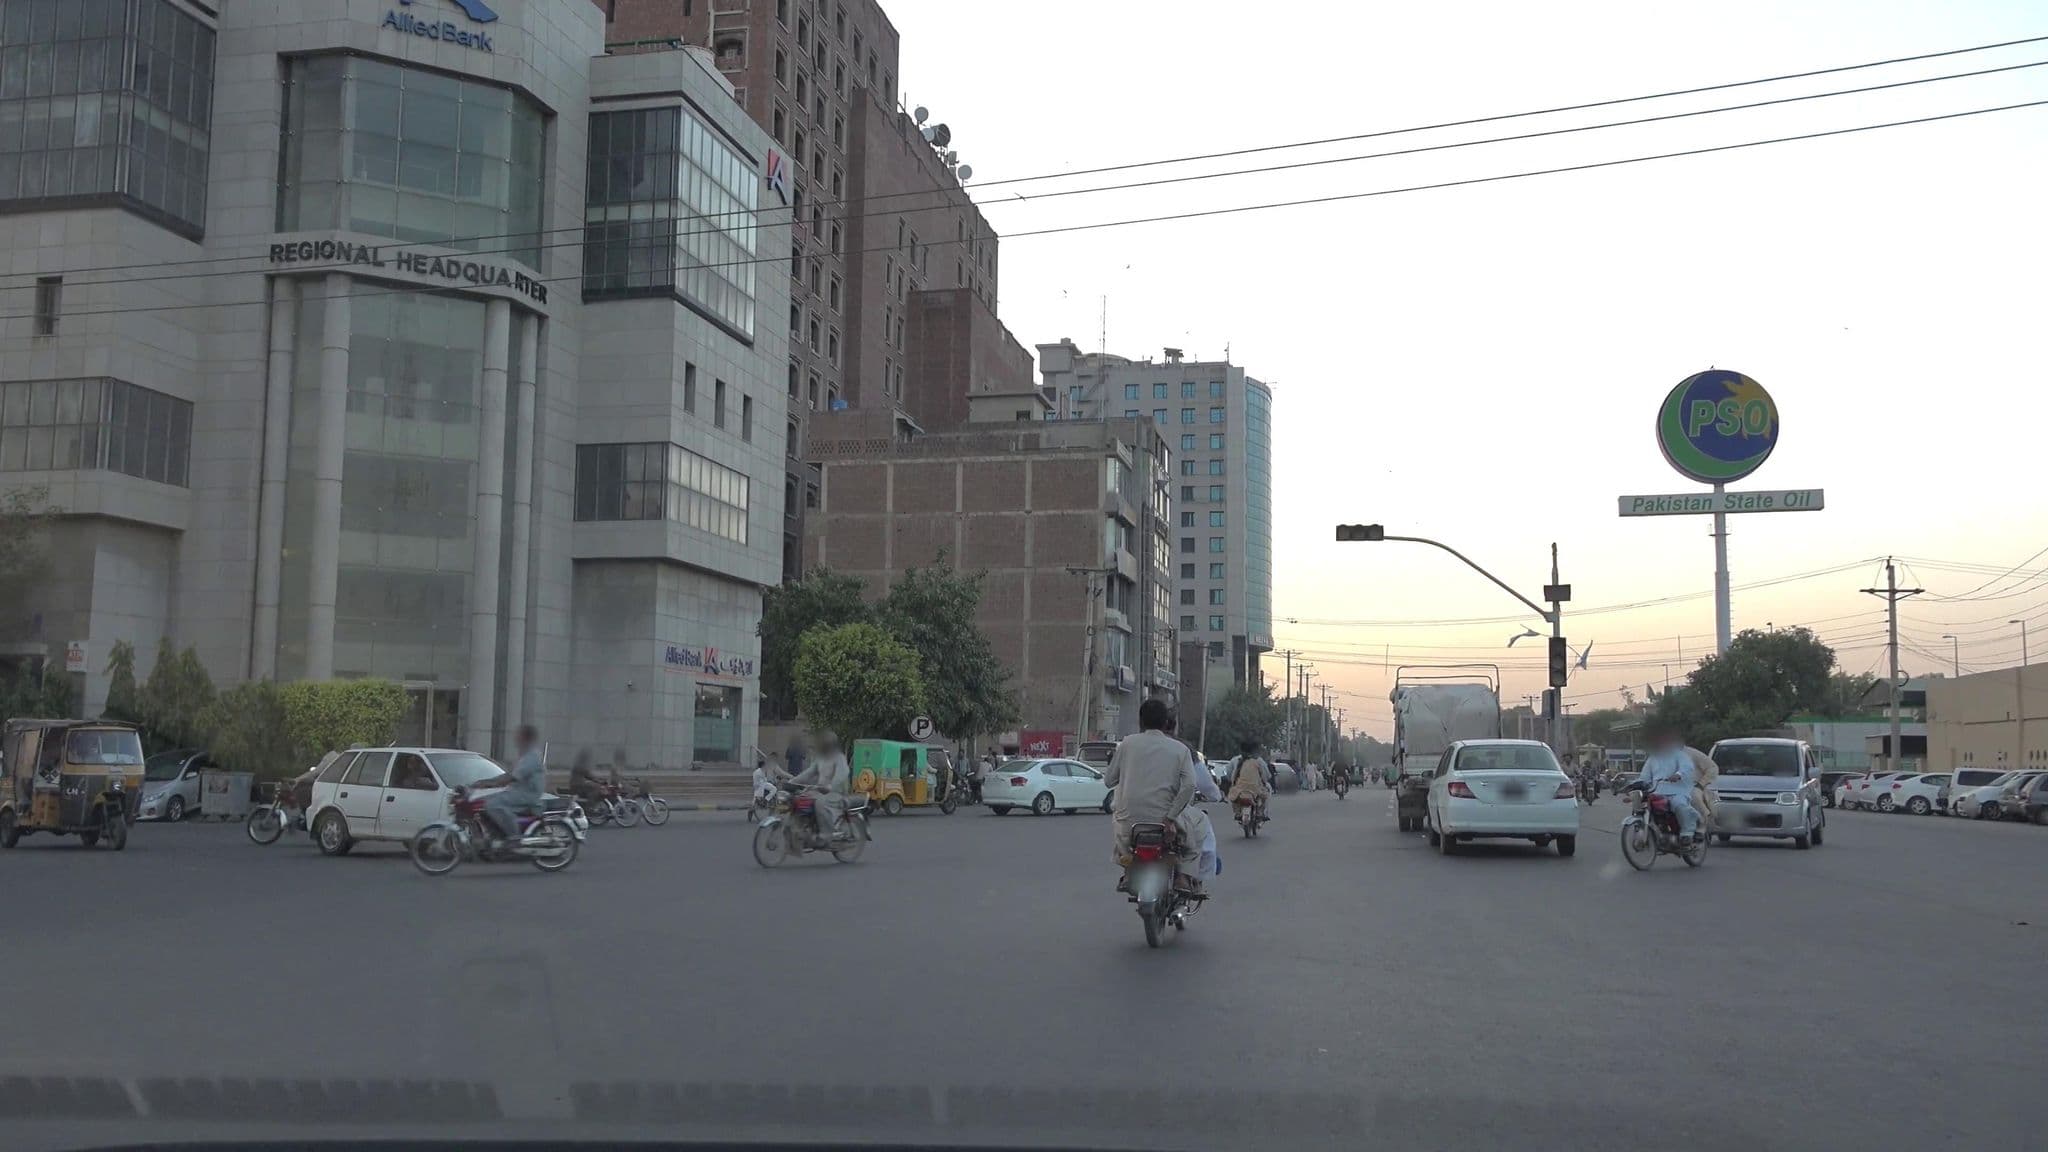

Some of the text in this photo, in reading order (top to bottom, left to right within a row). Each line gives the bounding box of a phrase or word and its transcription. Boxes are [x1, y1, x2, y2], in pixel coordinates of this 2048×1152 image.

[381, 9, 493, 52] Allied Bank
[270, 239, 548, 305] REGIONAL HEADQUARTER
[1688, 399, 1769, 438] PSO
[1632, 490, 1811, 513] Pakistan State Oil
[914, 718, 930, 736] P
[1030, 740, 1050, 752] NEXT
